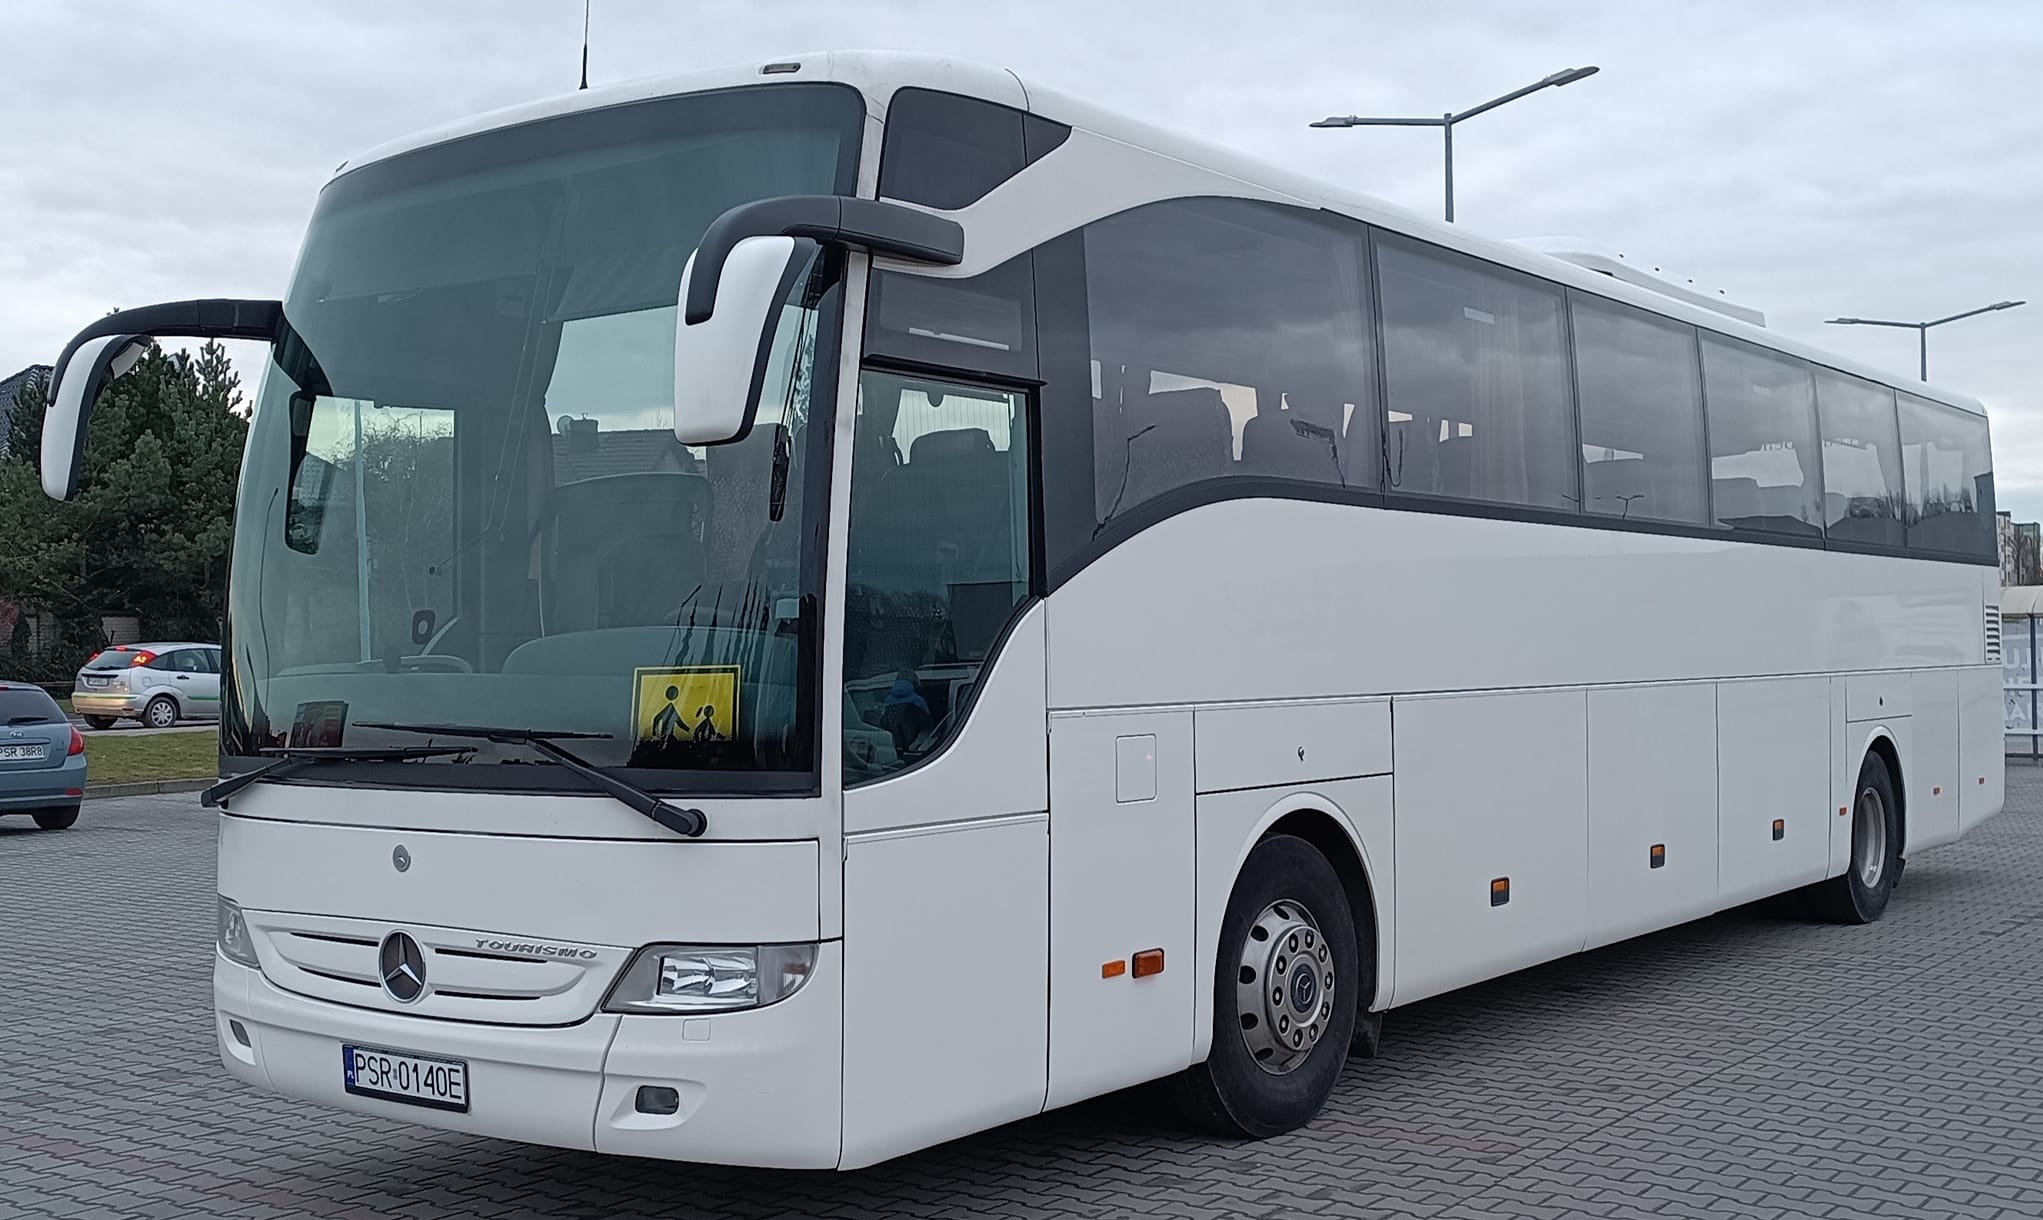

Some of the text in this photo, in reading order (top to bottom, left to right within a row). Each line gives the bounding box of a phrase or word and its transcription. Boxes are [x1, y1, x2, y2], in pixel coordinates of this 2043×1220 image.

[475, 939, 597, 959] TOURISMO
[355, 1053, 462, 1099] PSR 0140E
